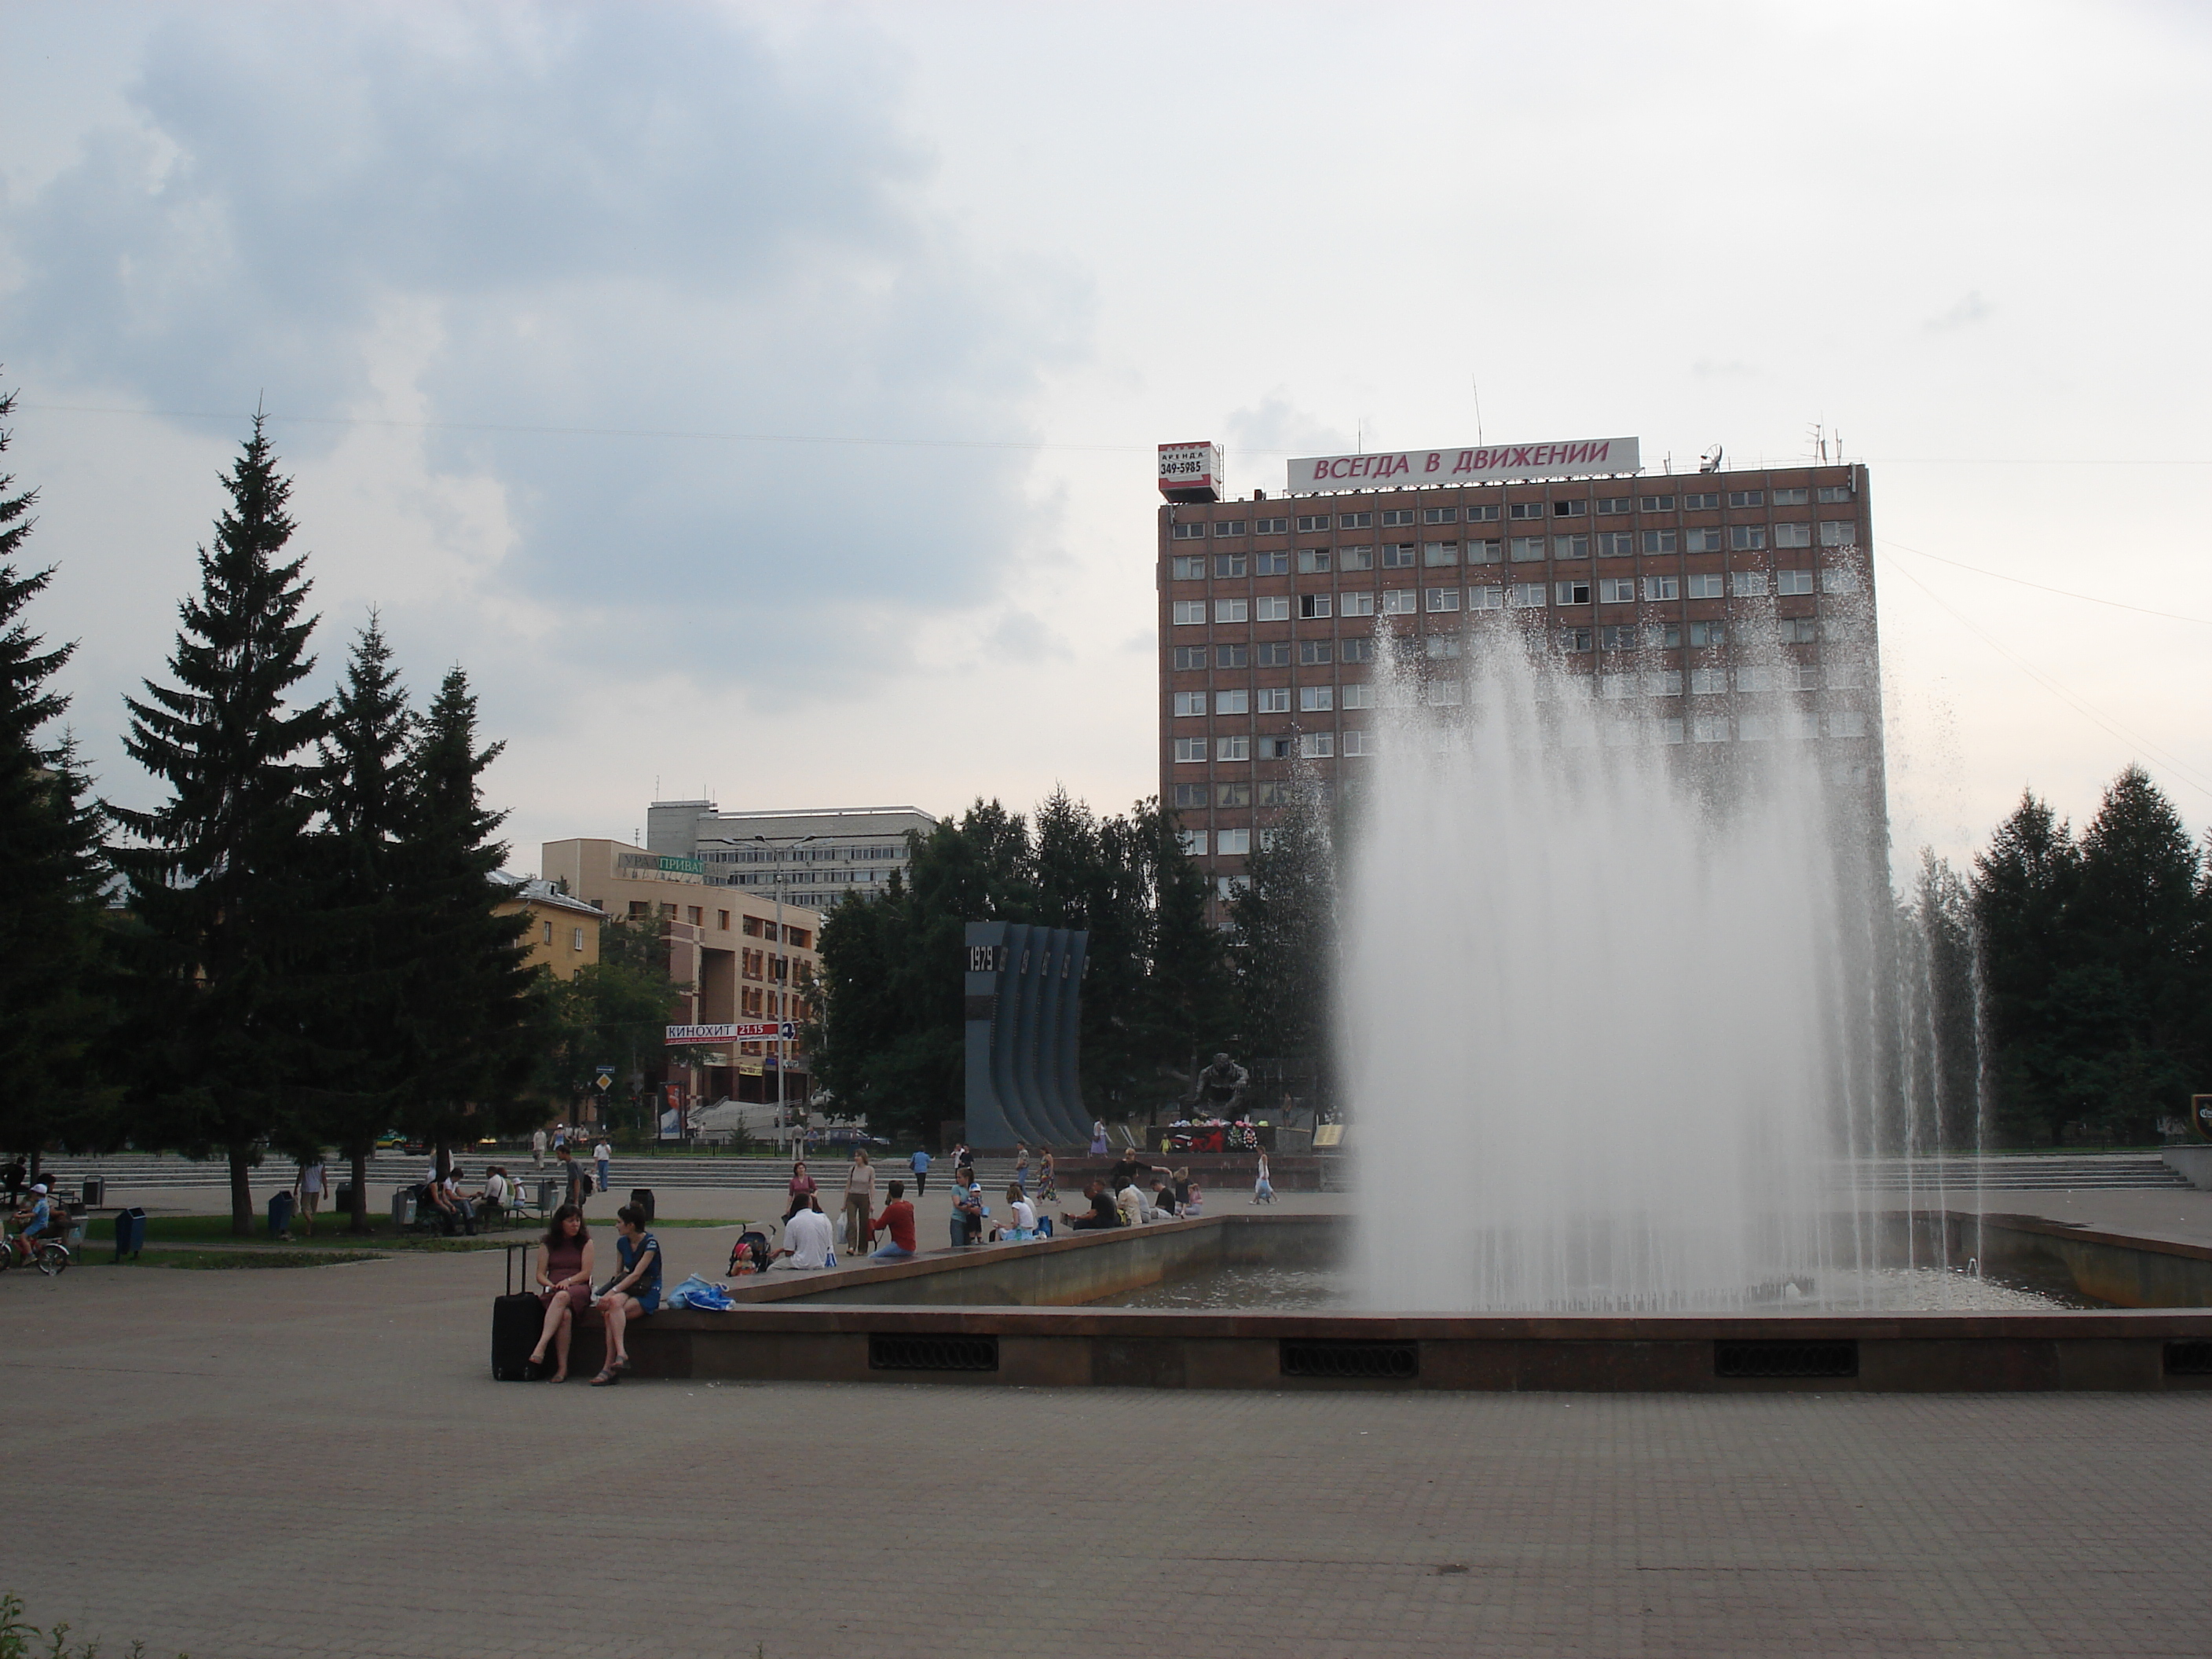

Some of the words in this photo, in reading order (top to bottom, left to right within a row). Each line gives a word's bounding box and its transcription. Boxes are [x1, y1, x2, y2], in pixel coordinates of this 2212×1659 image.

[1163, 452, 1203, 460] АРЕНДА
[1314, 454, 1409, 480] ВСЕГДА
[1424, 452, 1441, 473] В
[1452, 441, 1610, 474] ДВИЖЕНИИ
[1160, 461, 1201, 475] 349-5985
[970, 945, 993, 972] 1979
[668, 1025, 732, 1038] КИНОХИТ
[739, 1025, 764, 1035] 21.15
